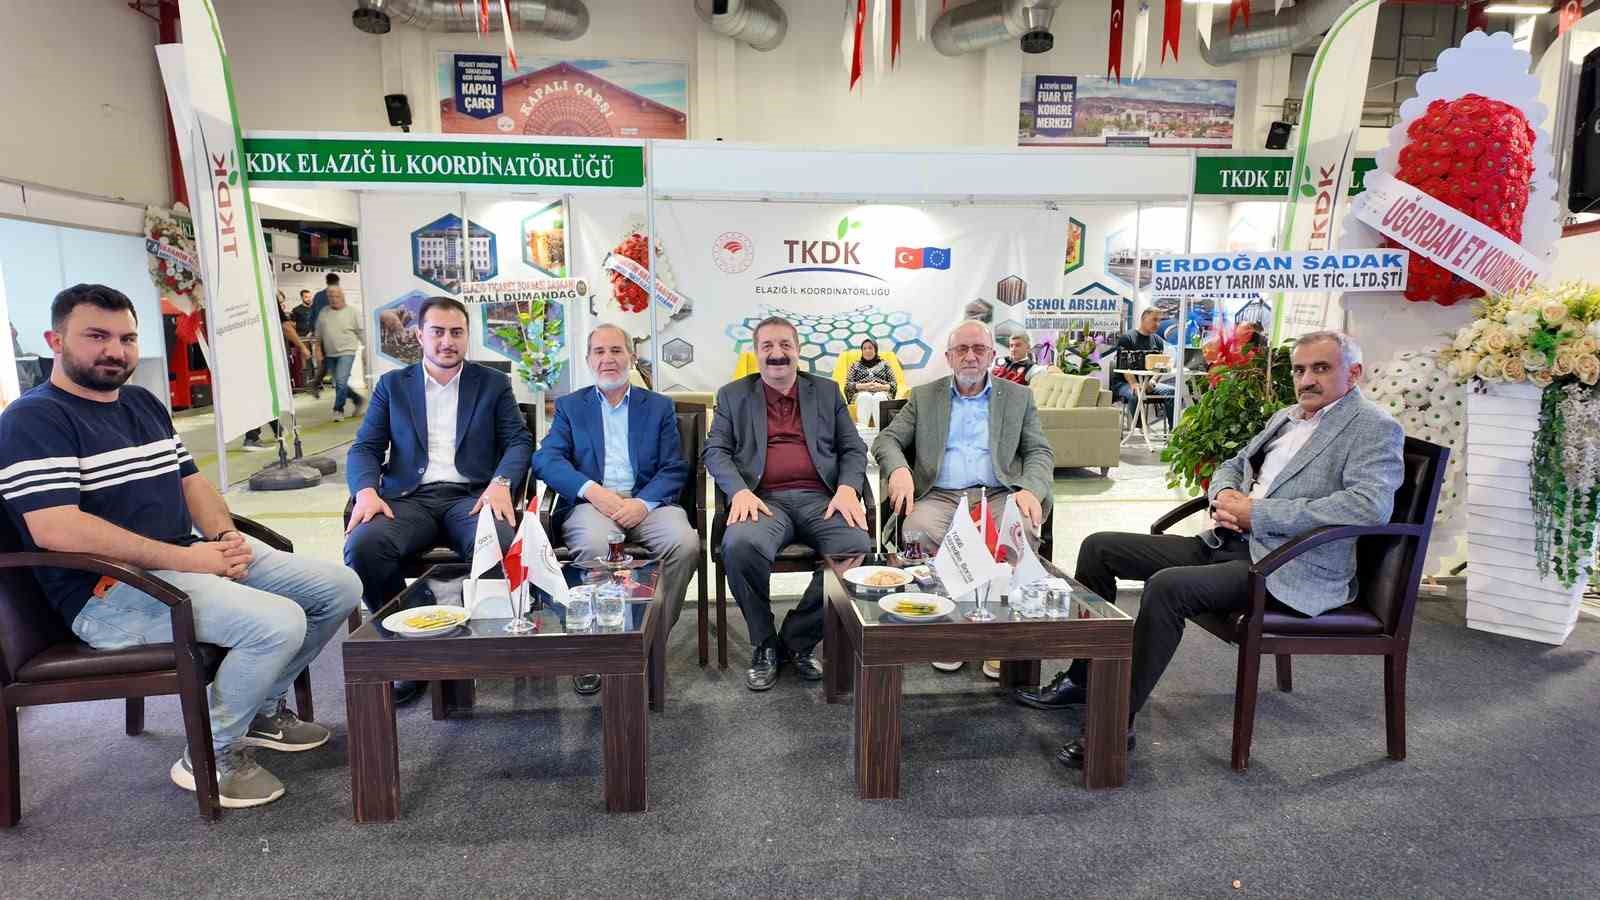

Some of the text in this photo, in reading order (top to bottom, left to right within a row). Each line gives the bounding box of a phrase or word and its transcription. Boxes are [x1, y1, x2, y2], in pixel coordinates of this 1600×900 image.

[461, 82, 497, 96] KAPALI
[1038, 91, 1073, 102] FUAR VE
[464, 96, 495, 113] ÇARŞI
[519, 80, 616, 119] KAPALI ÇARŞI
[1037, 103, 1073, 115] KONGRE
[1036, 117, 1073, 129] MERKEZİ
[245, 149, 615, 180] KDK ELAZIĞ İL KOORDİNATÖRLÜĞÜ
[1219, 169, 1270, 188] TKDK
[1381, 194, 1463, 260] UĞURDAN
[1452, 233, 1487, 270] ET
[783, 239, 861, 265] TKDK
[1155, 253, 1404, 273] ERDOĞAN SADAK
[1155, 268, 1404, 291] SADAKBEY TARIM SAN. VE TİC. LTD.ŞTİ
[1068, 298, 1117, 311] ARSLAN
